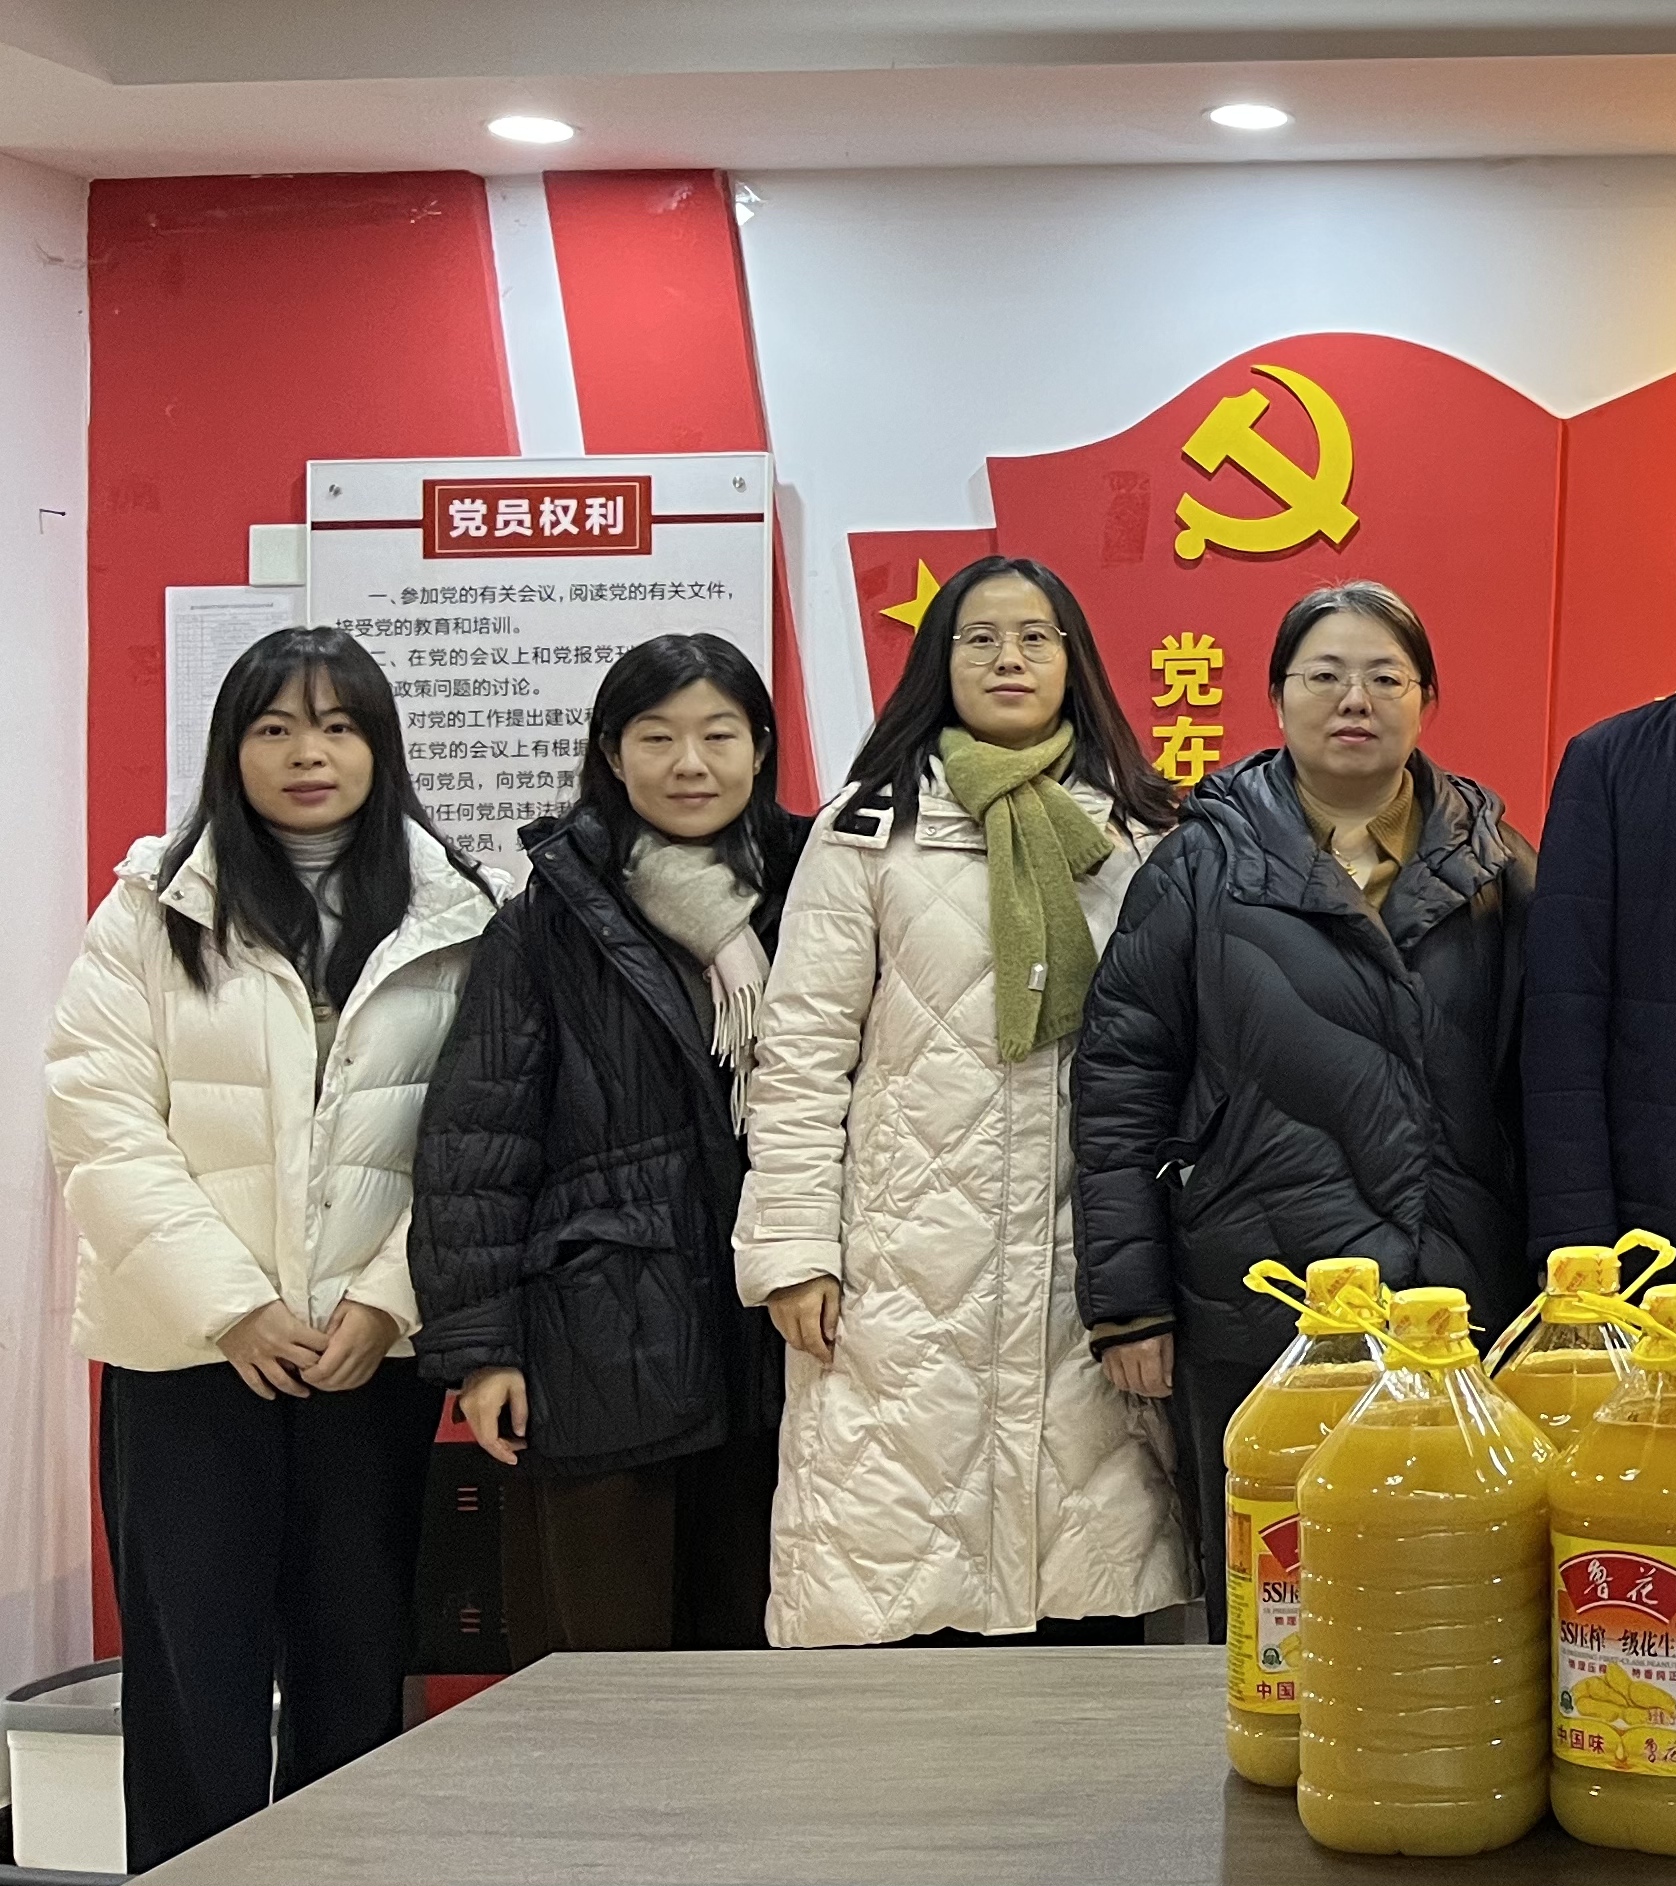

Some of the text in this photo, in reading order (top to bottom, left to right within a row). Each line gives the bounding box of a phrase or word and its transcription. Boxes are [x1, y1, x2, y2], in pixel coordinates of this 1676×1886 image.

[449, 496, 624, 538] 党员权利
[390, 678, 541, 699] 政策问题的讨论。
[1152, 632, 1224, 787] 党在
[408, 738, 589, 760] 在党的会议上有根据
[410, 770, 575, 791] 何党员，向党负责
[1583, 1558, 1659, 1605] 鲁花
[1257, 1682, 1295, 1700] 中国
[1557, 1724, 1605, 1754] 中国味
